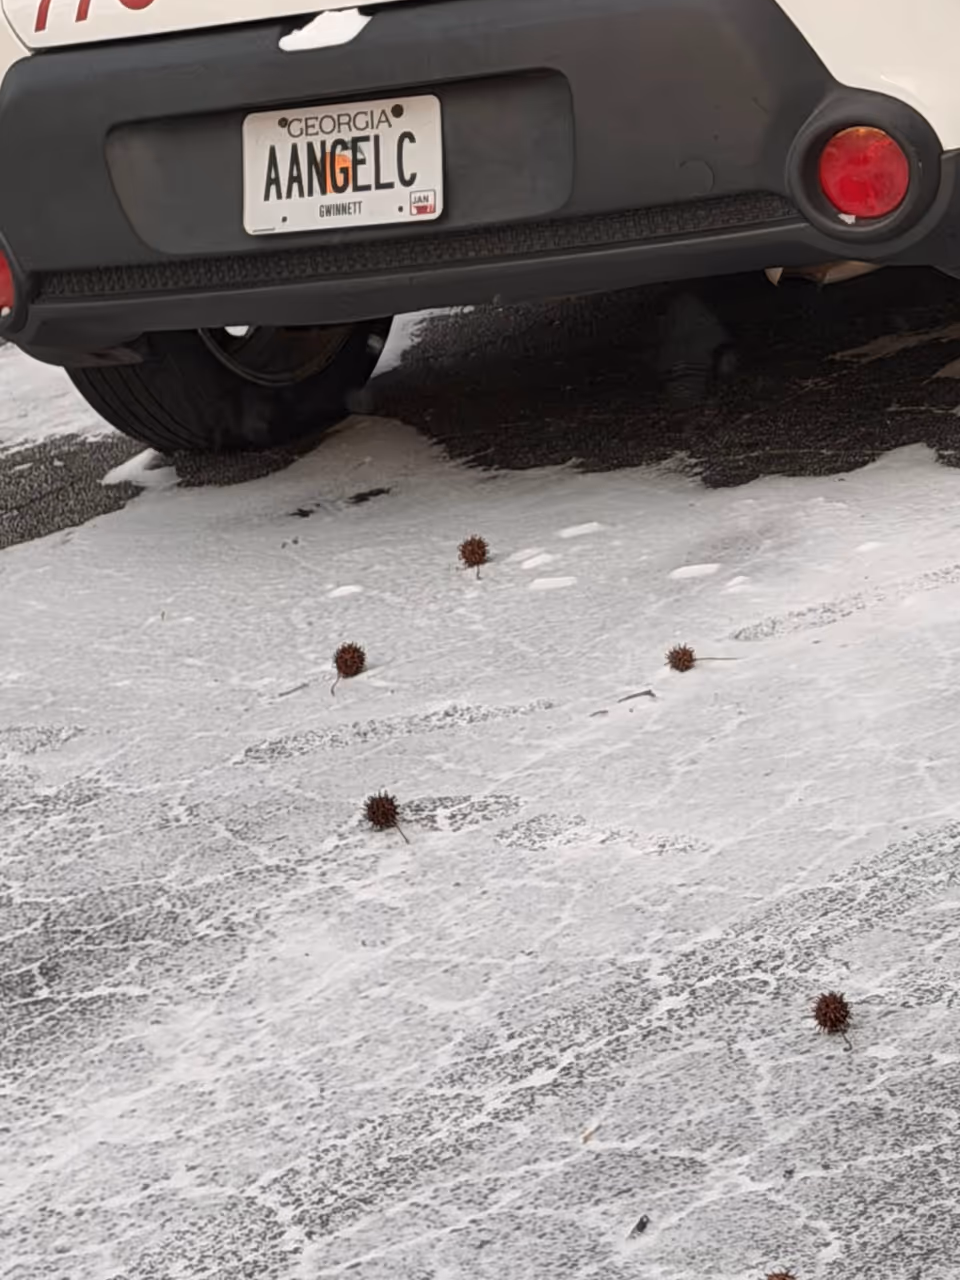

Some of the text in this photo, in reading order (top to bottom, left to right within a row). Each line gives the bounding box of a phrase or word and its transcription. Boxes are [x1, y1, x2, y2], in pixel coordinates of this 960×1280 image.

[287, 109, 392, 138] GEORGIA
[263, 131, 418, 202] AANGELC
[319, 201, 363, 218] GWINNETT
[413, 194, 430, 205] JAN
